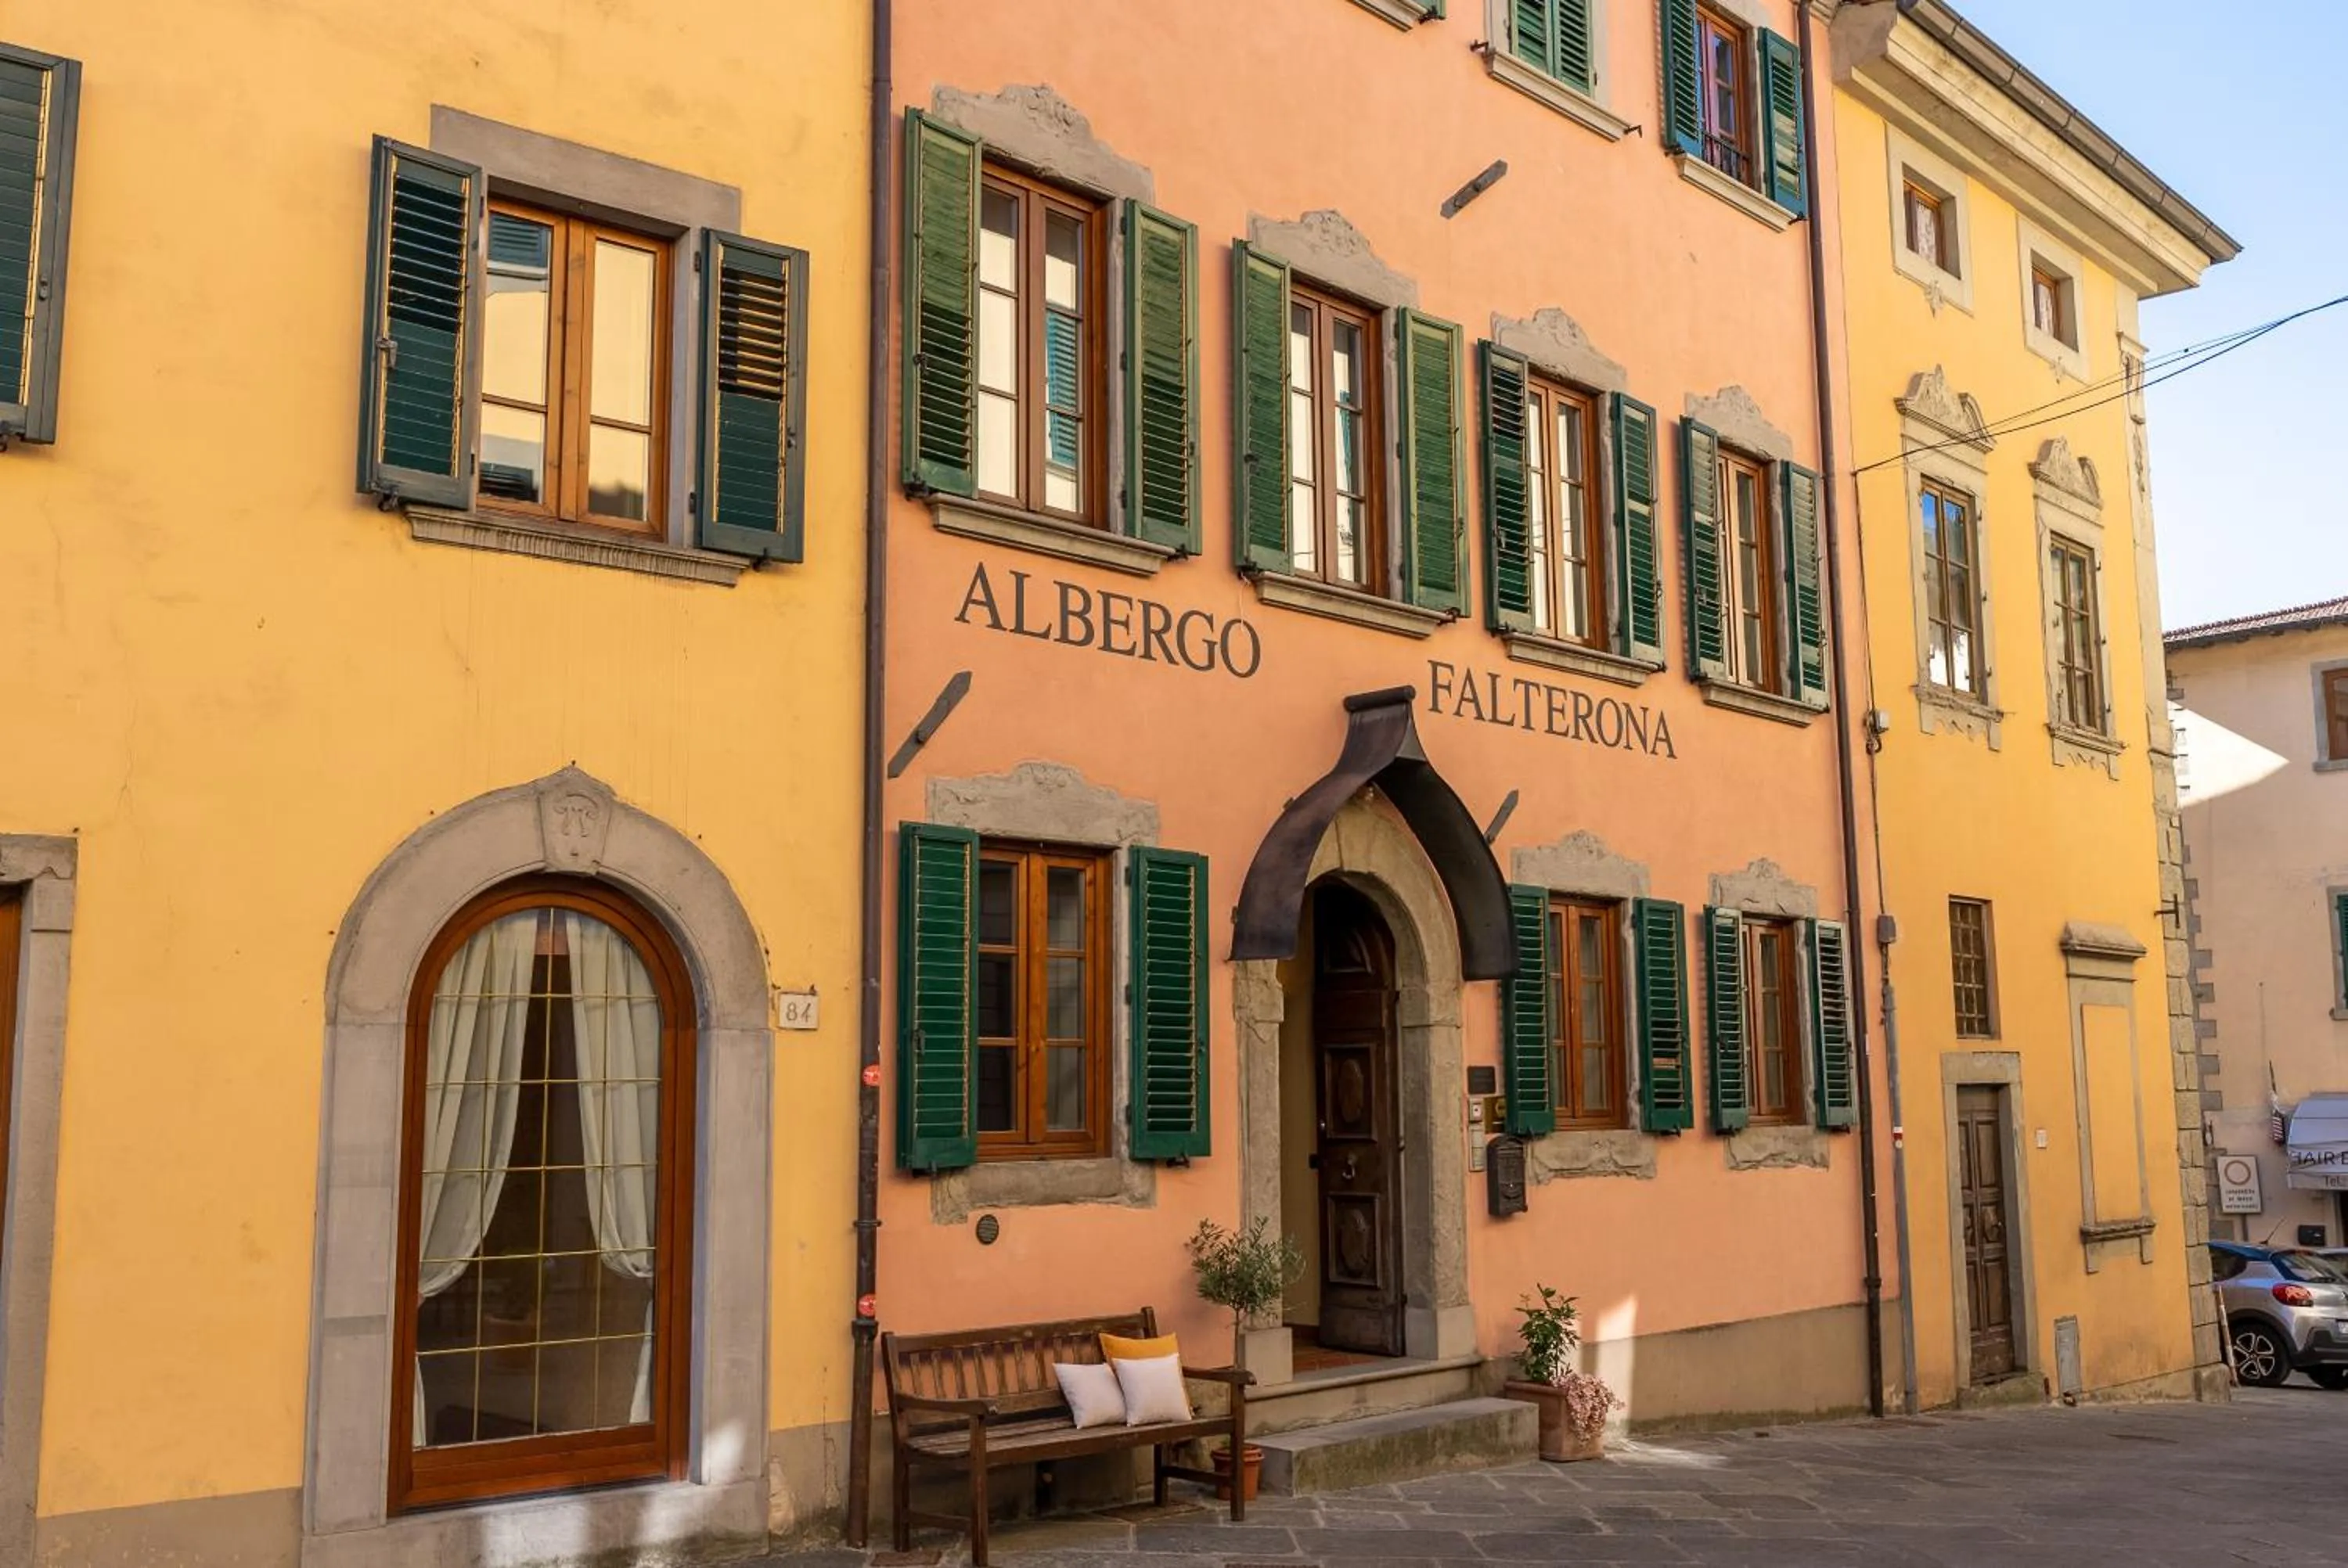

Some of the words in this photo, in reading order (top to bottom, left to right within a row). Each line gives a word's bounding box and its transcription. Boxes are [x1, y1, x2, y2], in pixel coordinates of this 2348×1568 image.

[955, 562, 1262, 679] ALBERGO
[1427, 660, 1677, 759] FALTERONA
[786, 1002, 812, 1023] 84
